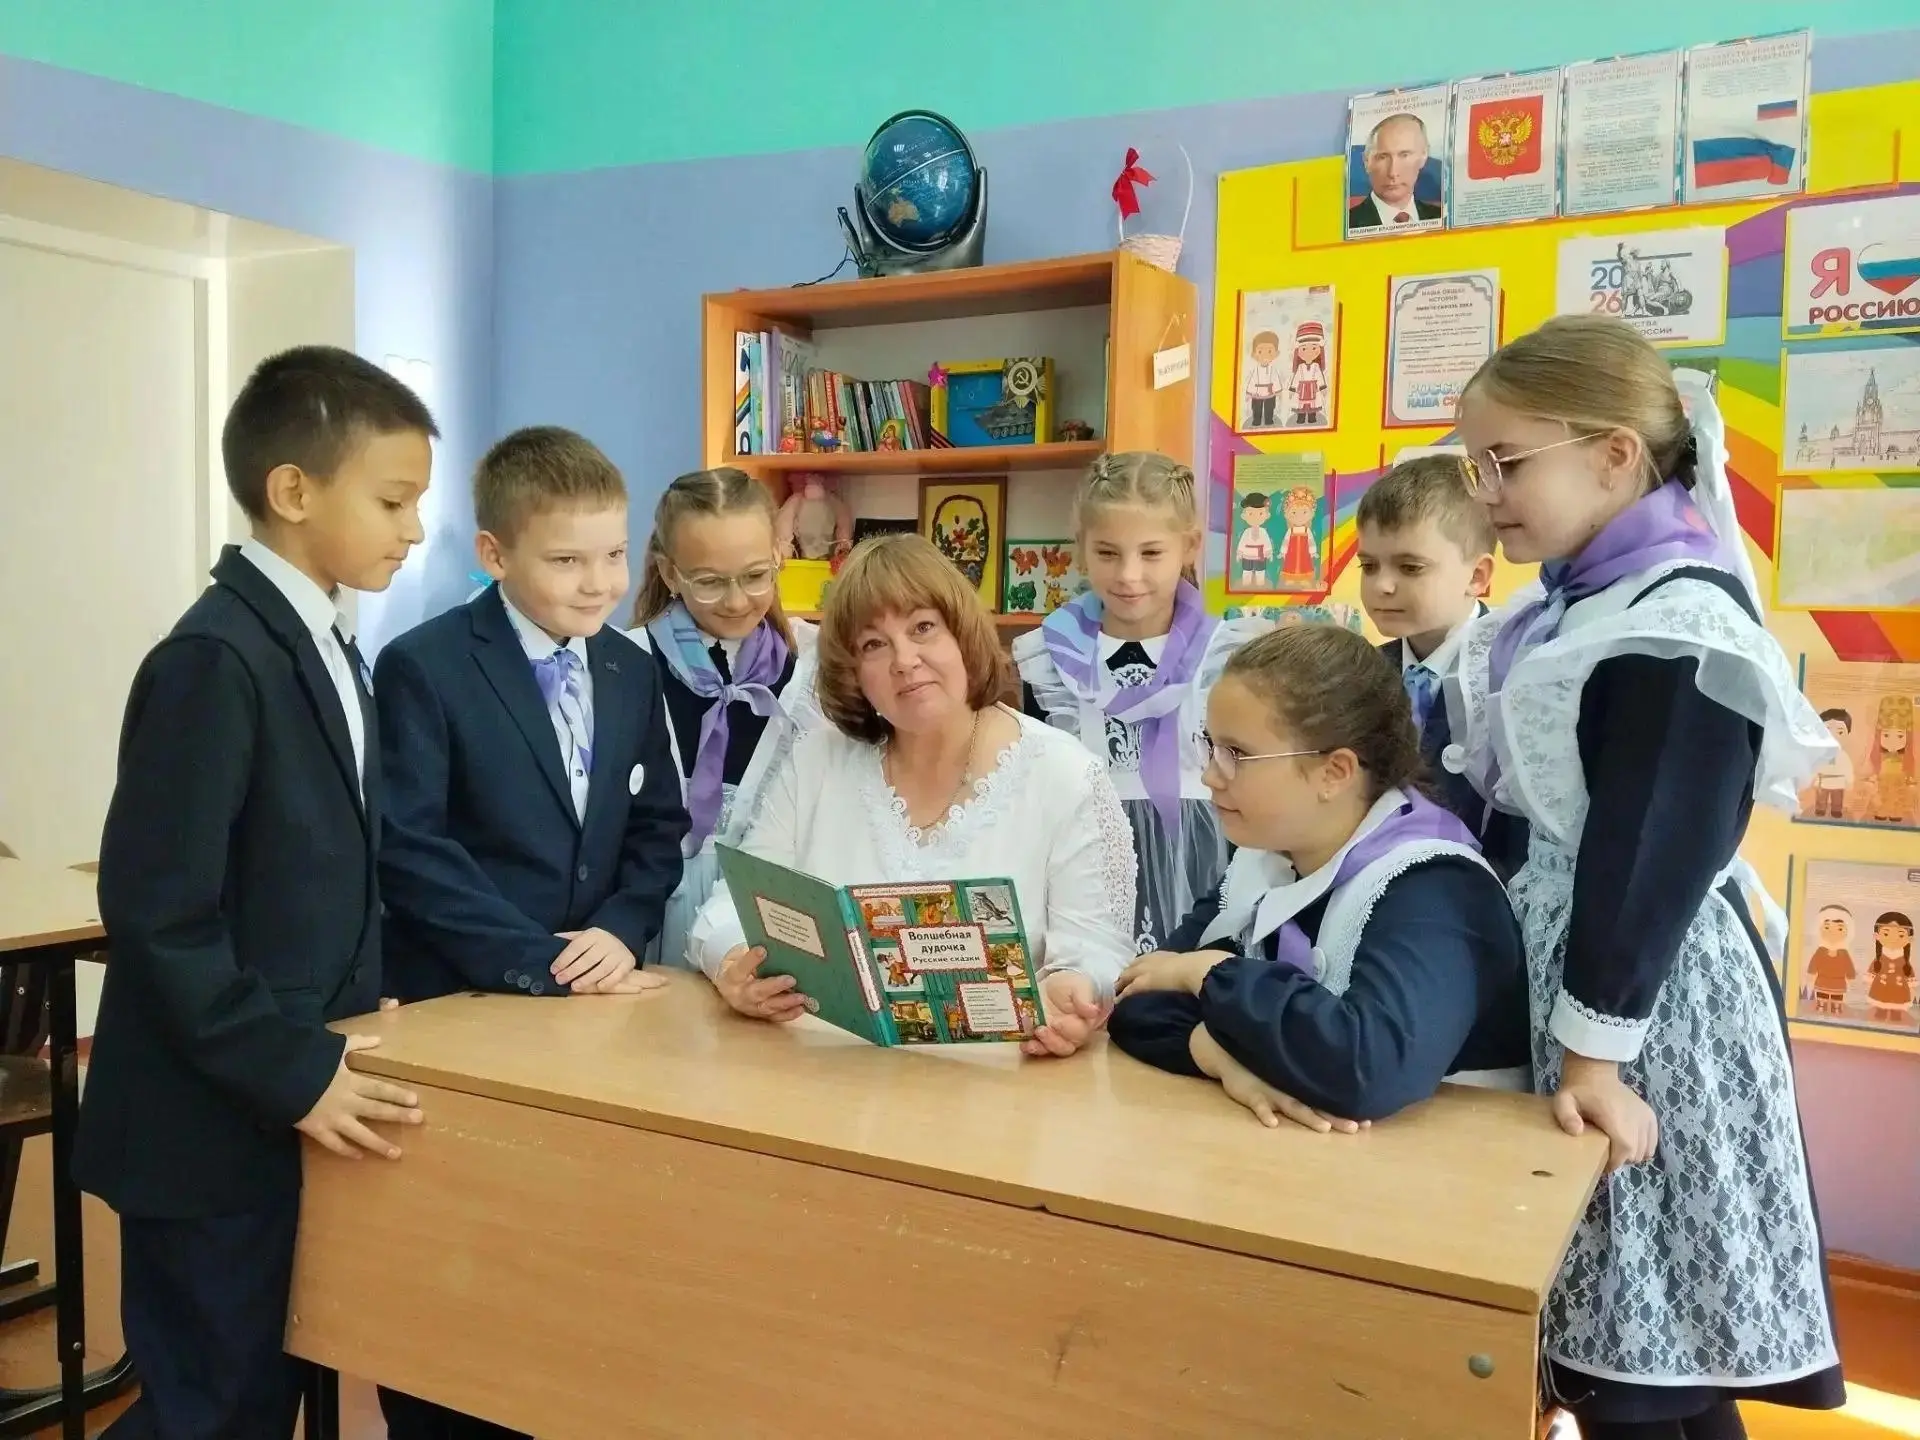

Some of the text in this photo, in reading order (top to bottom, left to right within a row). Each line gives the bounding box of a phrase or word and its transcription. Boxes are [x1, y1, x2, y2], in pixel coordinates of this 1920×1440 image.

[1591, 265, 1625, 290] 20
[1810, 247, 1851, 299] Я
[1590, 290, 1622, 313] 26
[1809, 297, 1920, 324] РОССИЮ
[1640, 327, 1672, 335] ОССИИ
[908, 930, 972, 941] Волшебная
[921, 943, 966, 954] дудочка
[912, 954, 980, 964] Русские сказки
